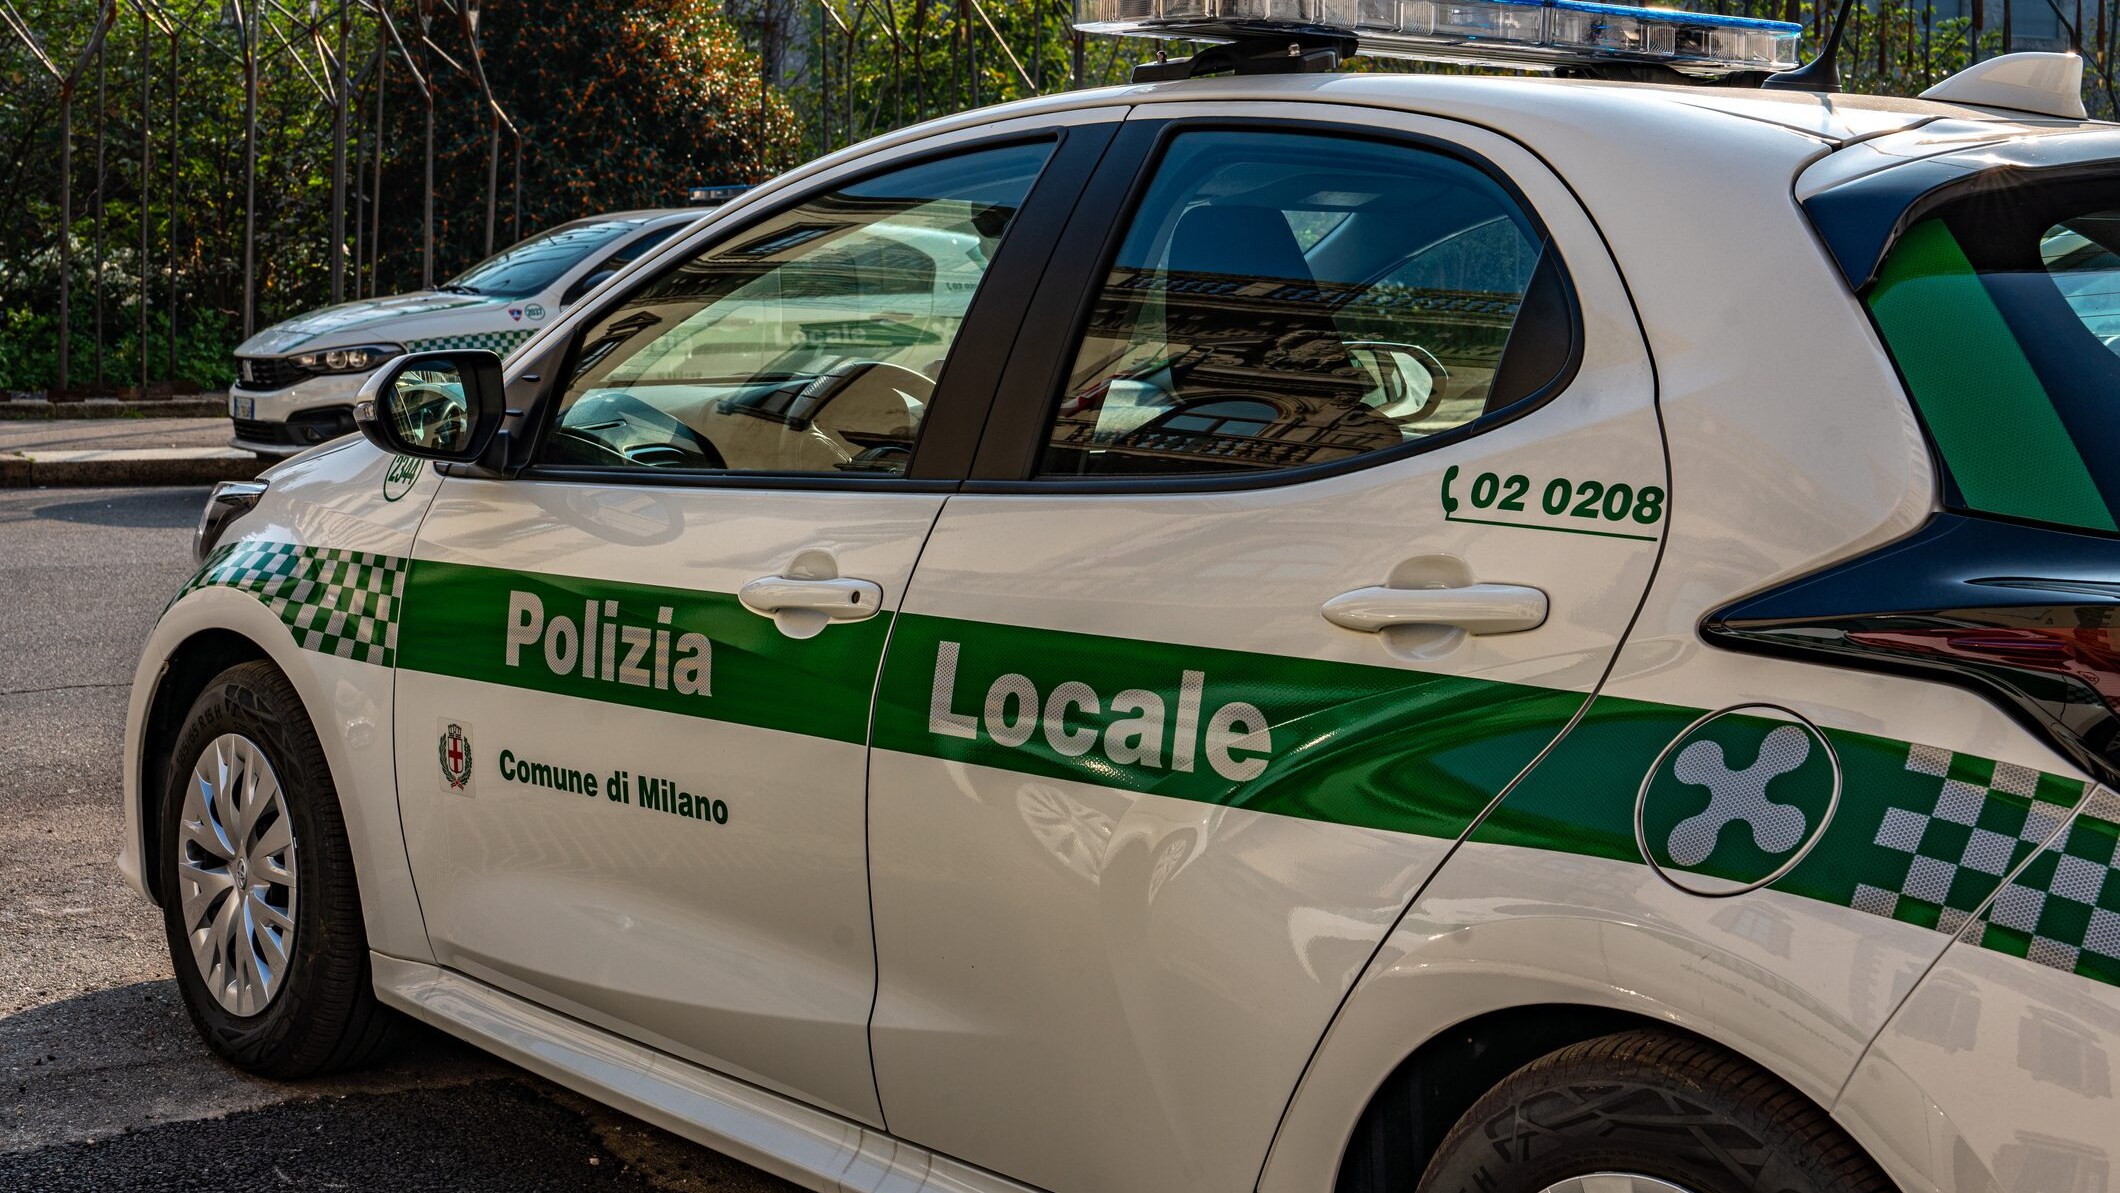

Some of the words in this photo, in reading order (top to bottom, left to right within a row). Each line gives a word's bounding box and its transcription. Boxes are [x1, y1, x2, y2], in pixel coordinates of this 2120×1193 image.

[774, 321, 867, 345] Locale
[388, 455, 421, 484] 2344
[1470, 472, 1530, 511] 02
[1542, 477, 1665, 524] 0208
[506, 590, 712, 697] Polizia
[928, 640, 1272, 782] Locale
[176, 723, 199, 767] 185/65
[499, 749, 598, 797] Comune
[607, 770, 629, 804] di
[638, 775, 728, 825] Milano
